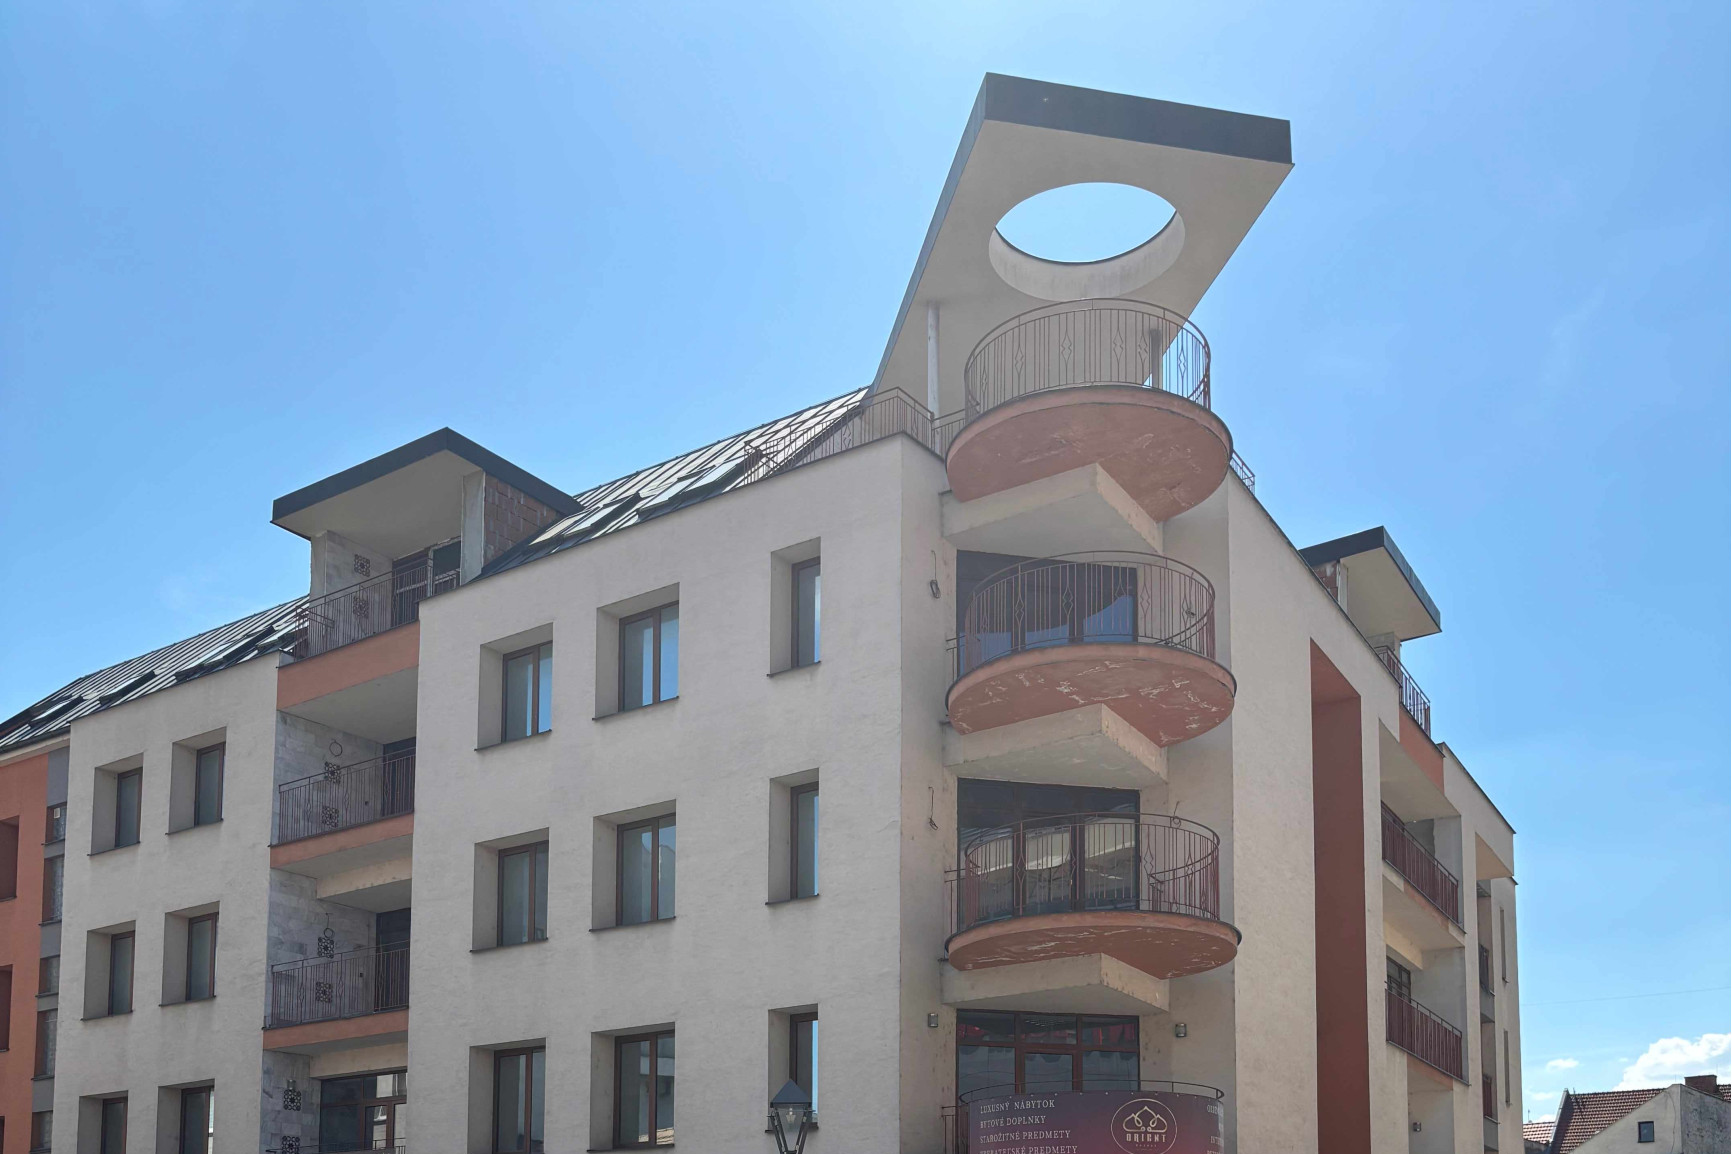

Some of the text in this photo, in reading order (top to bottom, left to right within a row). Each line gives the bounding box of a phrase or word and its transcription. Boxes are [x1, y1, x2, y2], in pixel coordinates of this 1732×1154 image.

[980, 1099, 1056, 1114] LUXUSNÝ NÁBYTOK
[980, 1115, 1046, 1129] BYTOVÉ DOPLNKY
[980, 1130, 1071, 1144] STAROŽITNÉ PREDMETY
[1126, 1133, 1166, 1143] ORIENT
[1028, 1145, 1078, 1154] PREDMETY
